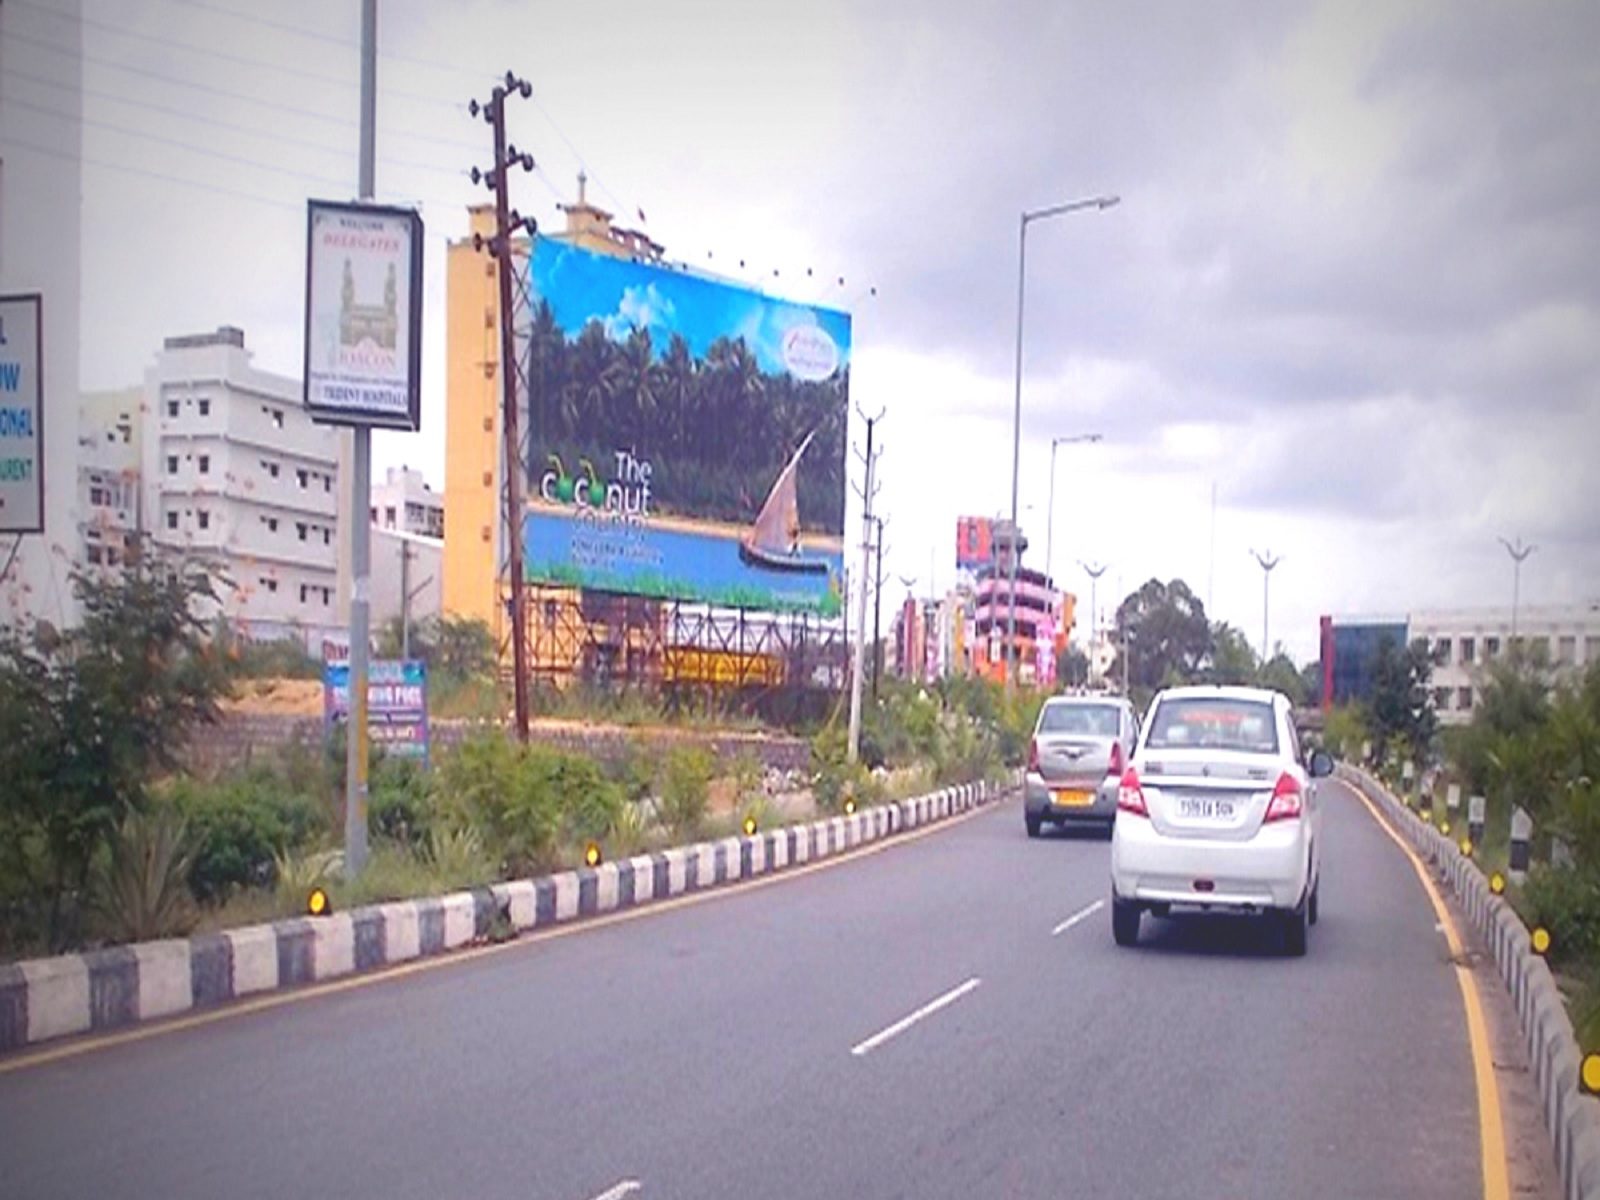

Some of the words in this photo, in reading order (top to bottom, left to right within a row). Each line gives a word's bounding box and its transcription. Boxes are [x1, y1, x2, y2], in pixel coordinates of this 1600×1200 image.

[323, 232, 400, 252] DELEGATES
[322, 384, 361, 402] TRIDENT
[614, 446, 652, 484] The
